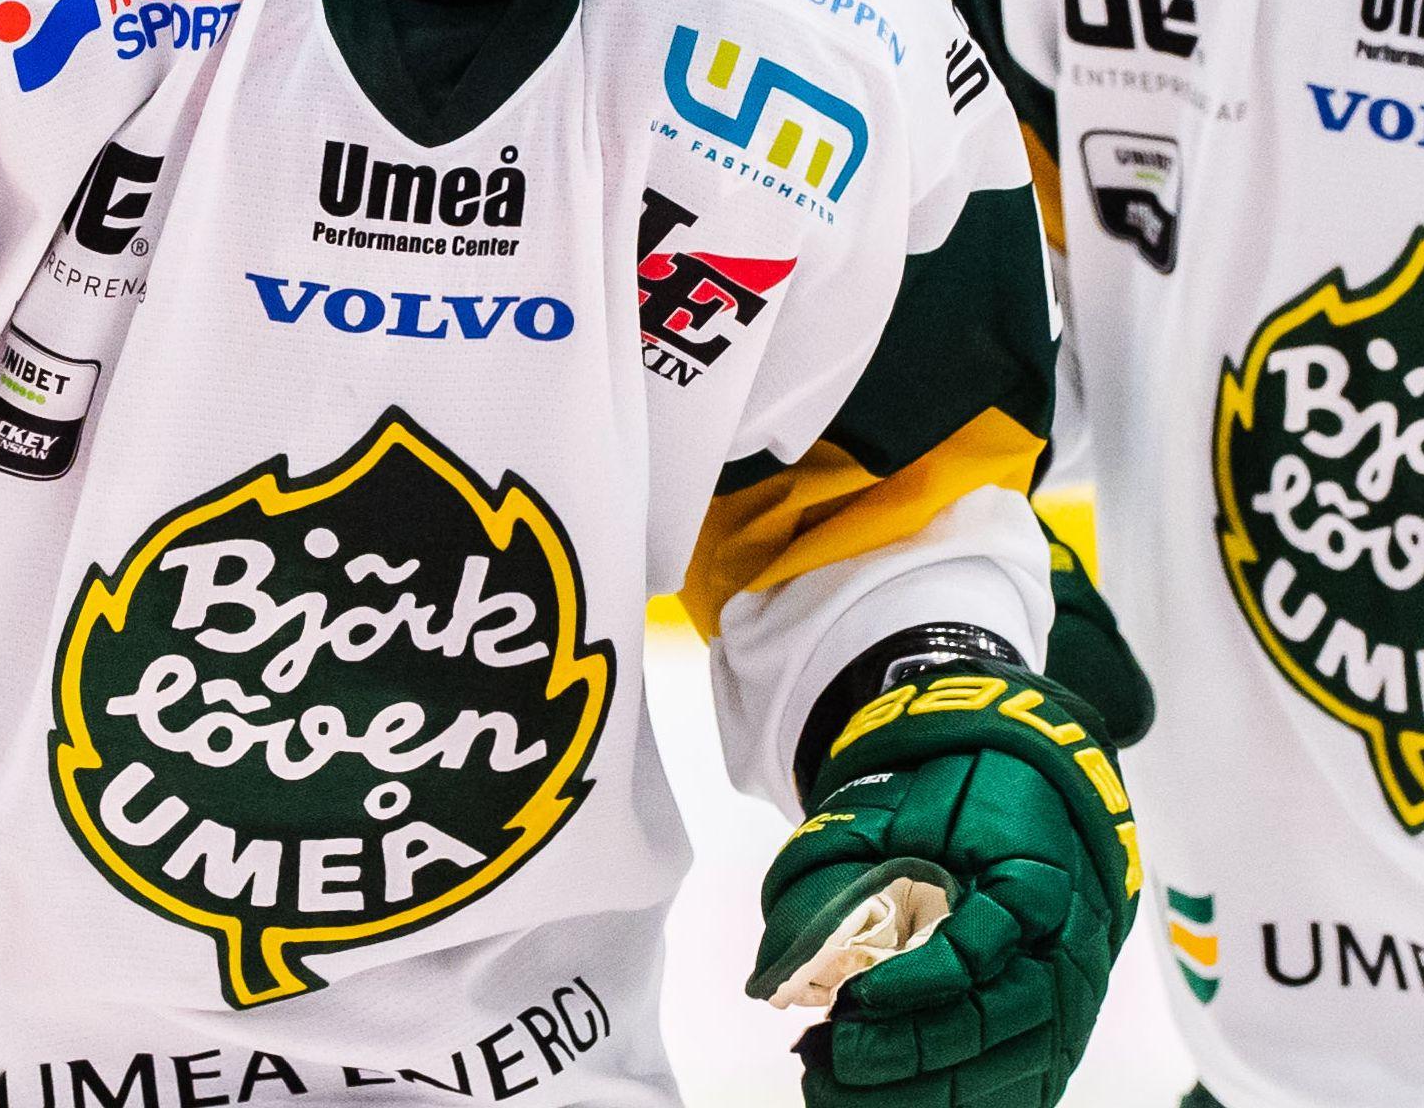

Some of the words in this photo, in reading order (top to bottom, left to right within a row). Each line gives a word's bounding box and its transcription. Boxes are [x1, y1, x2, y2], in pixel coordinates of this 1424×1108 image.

[113, 2, 243, 60] SPORT
[318, 140, 526, 229] Umeå
[691, 140, 835, 226] FASTIGHETER
[312, 220, 447, 256] Performance
[452, 235, 520, 259] Center
[245, 272, 575, 343] VOLVO
[2, 345, 71, 395] NIBET
[98, 762, 488, 914] UMEÅ
